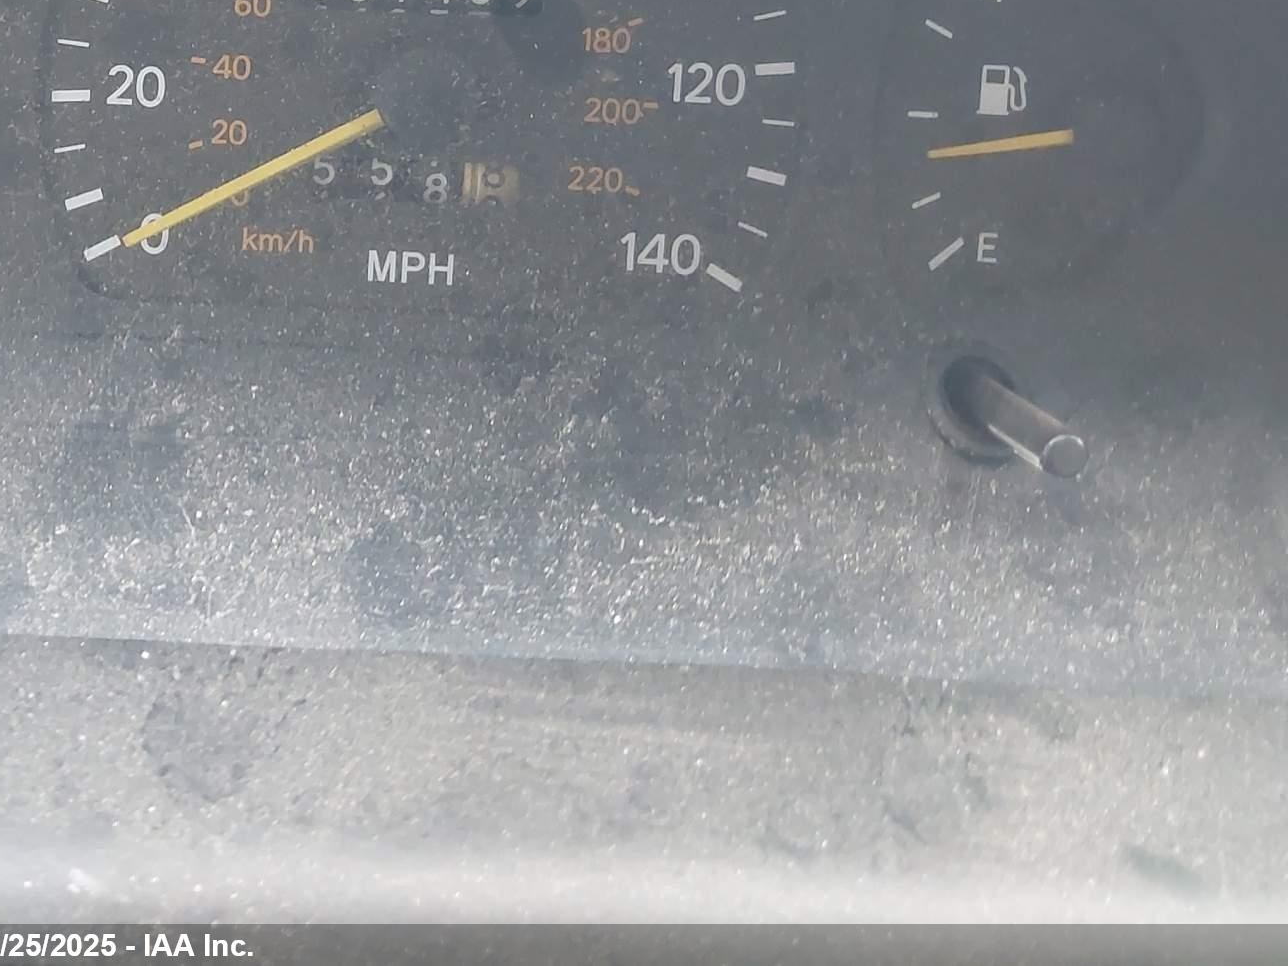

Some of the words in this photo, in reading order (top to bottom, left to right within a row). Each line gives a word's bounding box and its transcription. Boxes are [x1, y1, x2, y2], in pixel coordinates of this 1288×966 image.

[582, 27, 632, 53] 180
[213, 54, 251, 81] 40
[106, 65, 167, 108] 20
[667, 62, 746, 106] 120
[584, 97, 640, 125] 200
[211, 119, 248, 146] 20
[567, 165, 624, 194] 220
[140, 213, 169, 255] 0
[242, 227, 314, 253] km/h
[976, 232, 999, 264] E
[367, 249, 455, 287] MPH
[620, 231, 701, 276] 140
